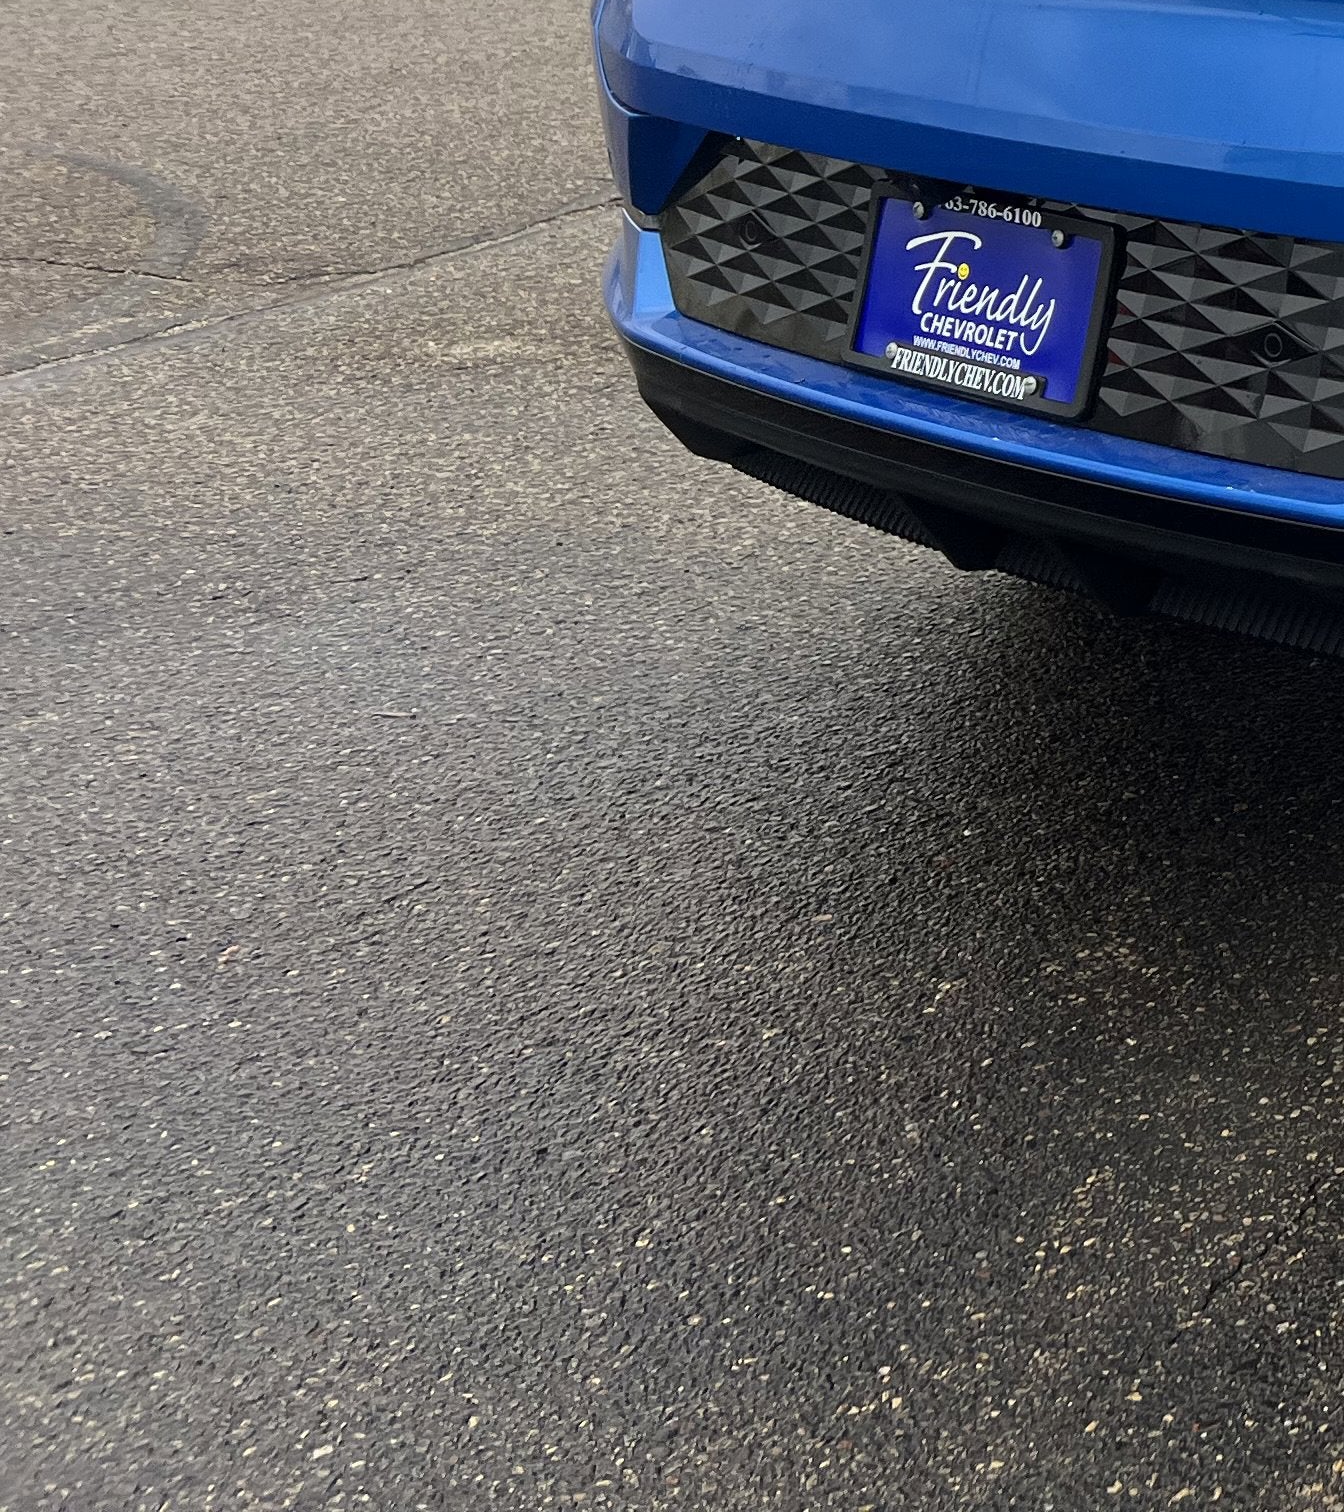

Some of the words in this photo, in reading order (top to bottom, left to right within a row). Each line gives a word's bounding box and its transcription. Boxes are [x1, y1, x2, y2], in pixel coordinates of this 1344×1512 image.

[938, 195, 1043, 228] 63-786-6100
[905, 230, 1056, 356] Friendly
[920, 311, 1019, 352] CHEVROLET
[912, 335, 1021, 370] WWW.FRIENDLYCHEV.COM
[890, 347, 1028, 400] FRIENDLYCHEV.COM
